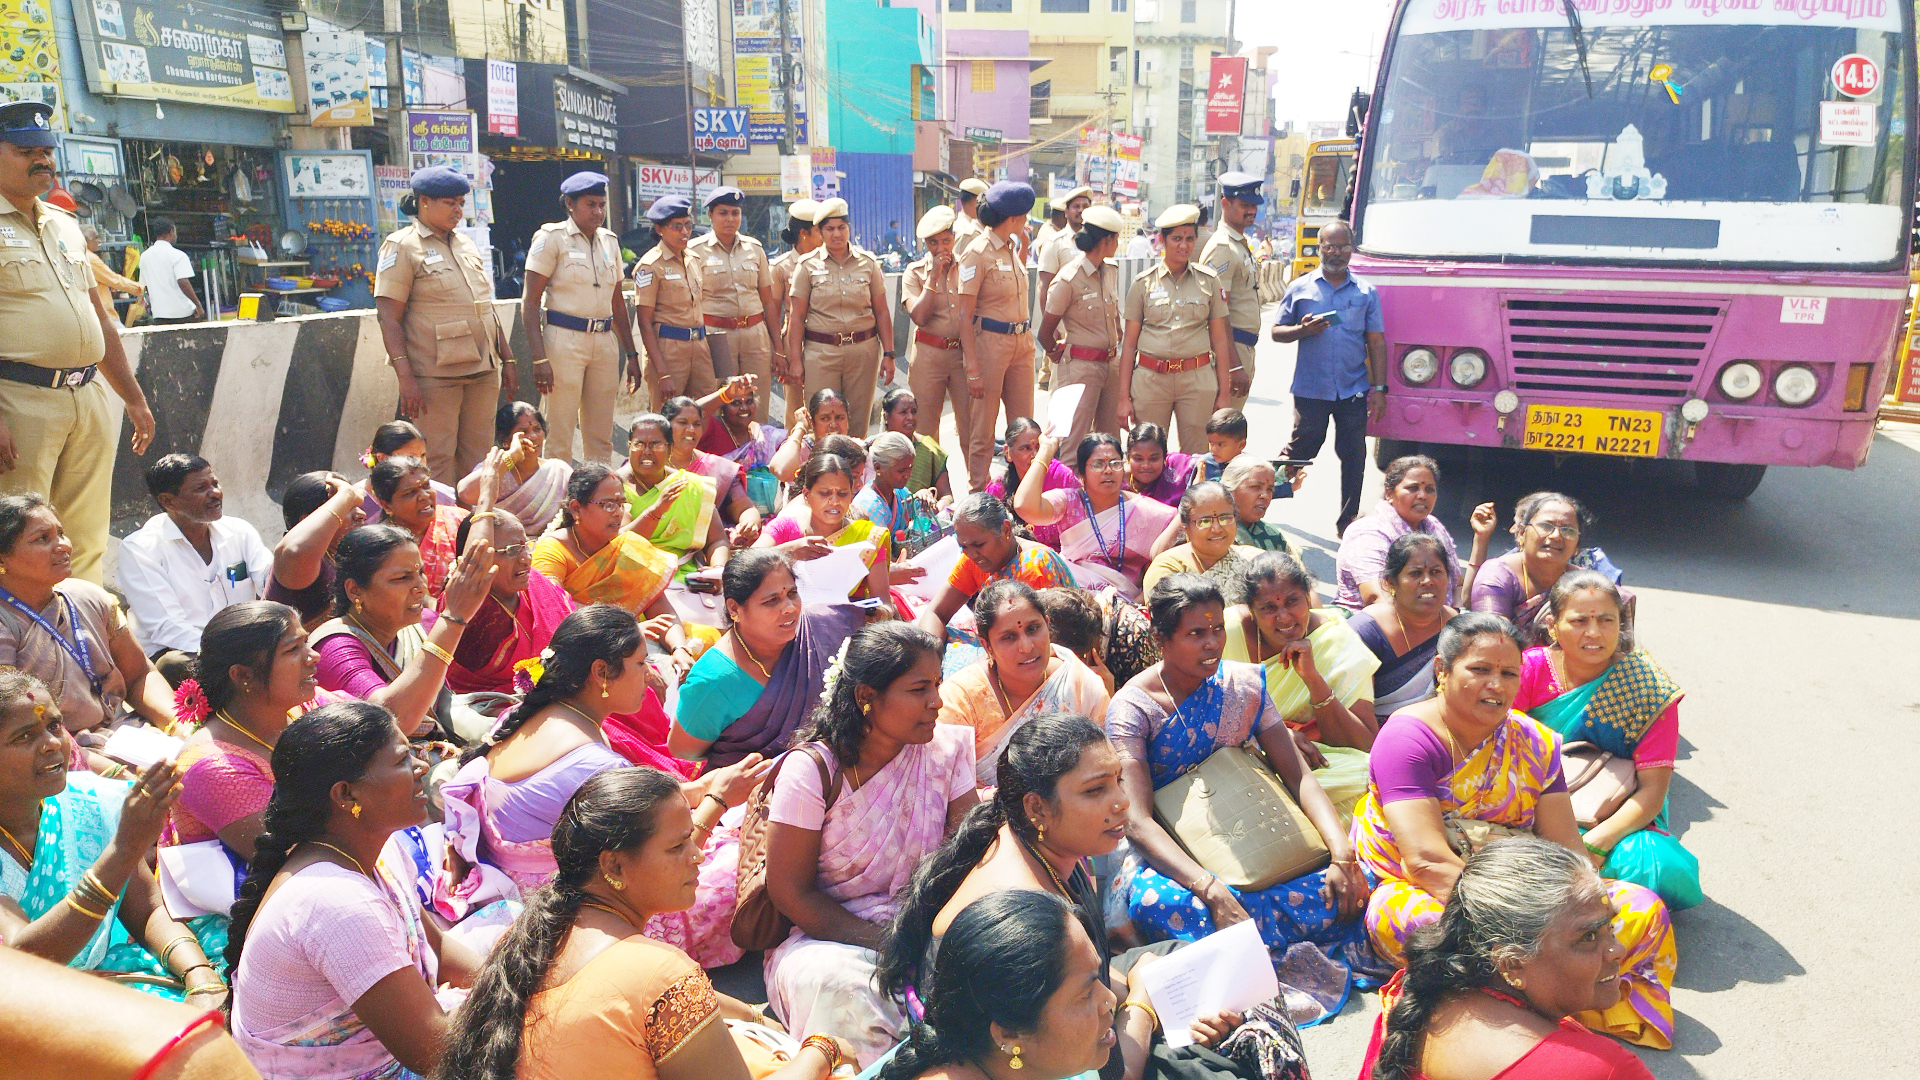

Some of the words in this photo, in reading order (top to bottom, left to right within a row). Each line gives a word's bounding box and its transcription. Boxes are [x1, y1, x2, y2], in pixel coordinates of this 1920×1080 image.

[490, 63, 515, 83] TOLET
[1835, 63, 1875, 89] 14.B
[560, 87, 593, 119] SUNDAR
[594, 97, 617, 125] LODGE
[694, 109, 747, 133] SKV
[695, 133, 715, 151] புக்
[641, 167, 673, 184] SKV
[380, 180, 411, 189] STORES
[1789, 298, 1820, 310] VLR
[1793, 312, 1815, 321] TPR
[1563, 413, 1582, 428] 23
[1608, 416, 1652, 433] TN23
[1544, 433, 1585, 450] 2221
[1595, 436, 1651, 454] N2221
